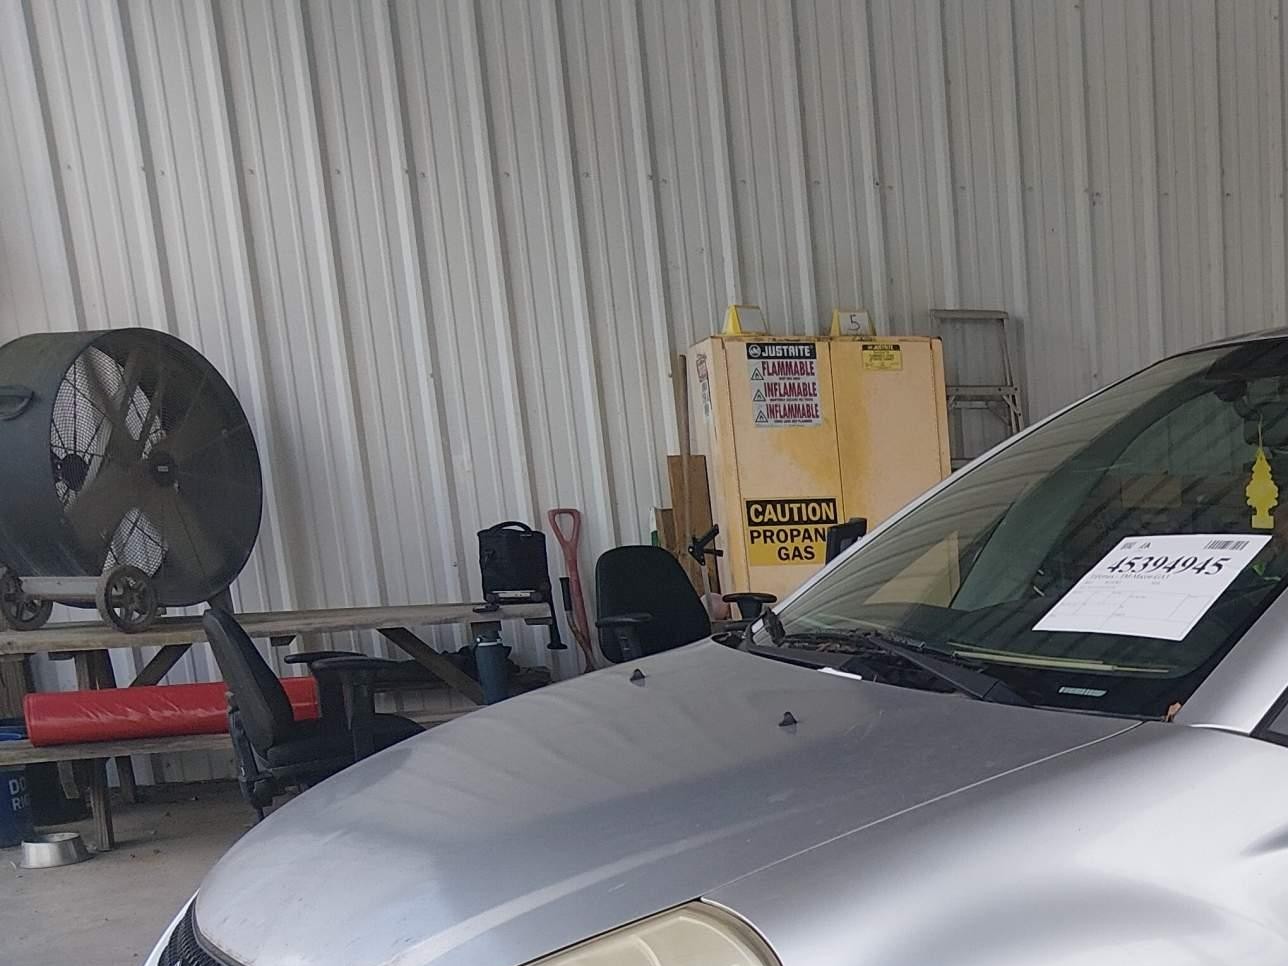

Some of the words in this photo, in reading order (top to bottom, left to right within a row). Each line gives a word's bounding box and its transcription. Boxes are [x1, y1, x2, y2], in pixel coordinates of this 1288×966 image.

[848, 313, 861, 331] 5
[761, 345, 811, 357] JUSTRITE
[761, 360, 816, 377] FLAMMABLE
[763, 381, 818, 398] INFLAMABLE
[766, 403, 820, 419] INFLAMMABLE
[750, 502, 835, 523] CAUTION
[749, 527, 827, 545] PROPAN
[777, 545, 816, 561] GAS
[1106, 555, 1231, 575] 45394945
